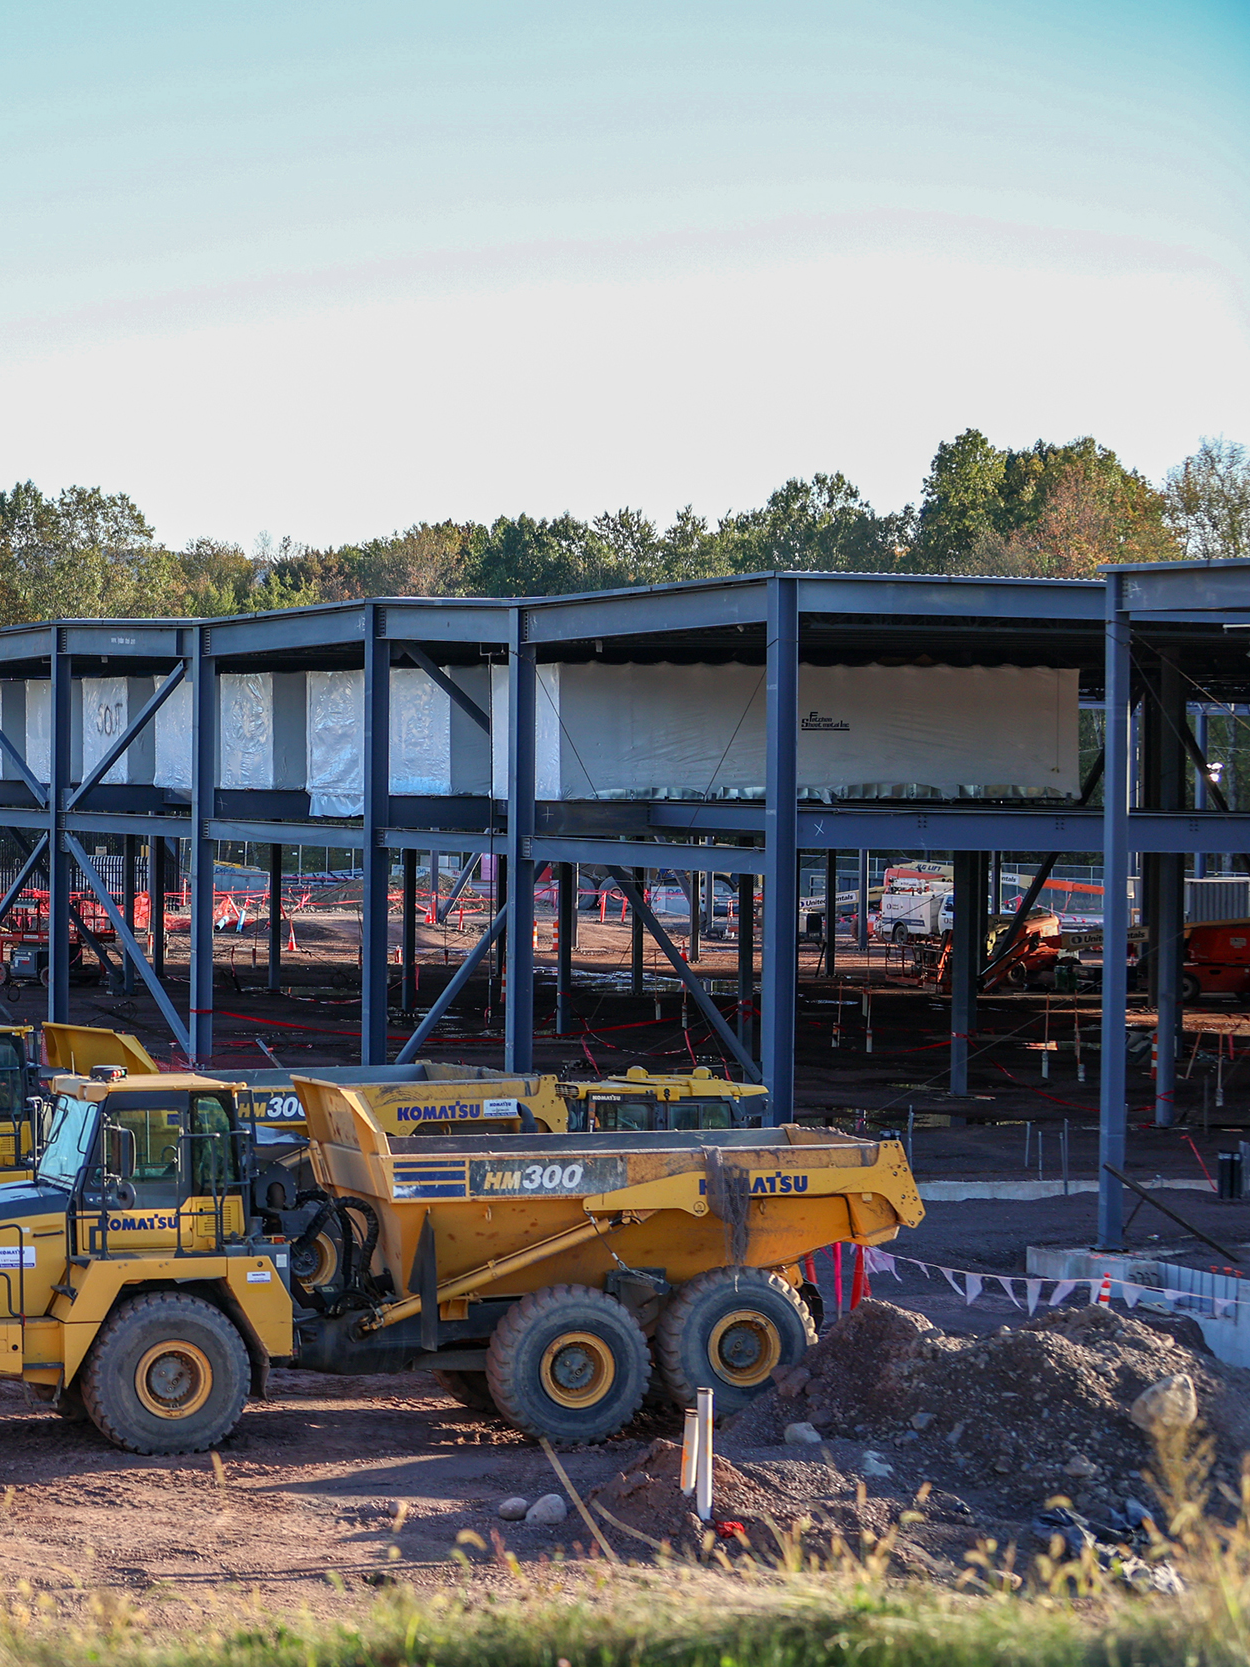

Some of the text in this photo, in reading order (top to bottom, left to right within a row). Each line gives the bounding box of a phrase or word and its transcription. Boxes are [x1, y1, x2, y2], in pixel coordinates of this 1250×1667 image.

[801, 718, 822, 728] Sheet
[928, 864, 942, 872] LIFT
[836, 894, 854, 902] ntals
[397, 1101, 481, 1121] KOMATSU
[483, 1164, 584, 1190] HM300
